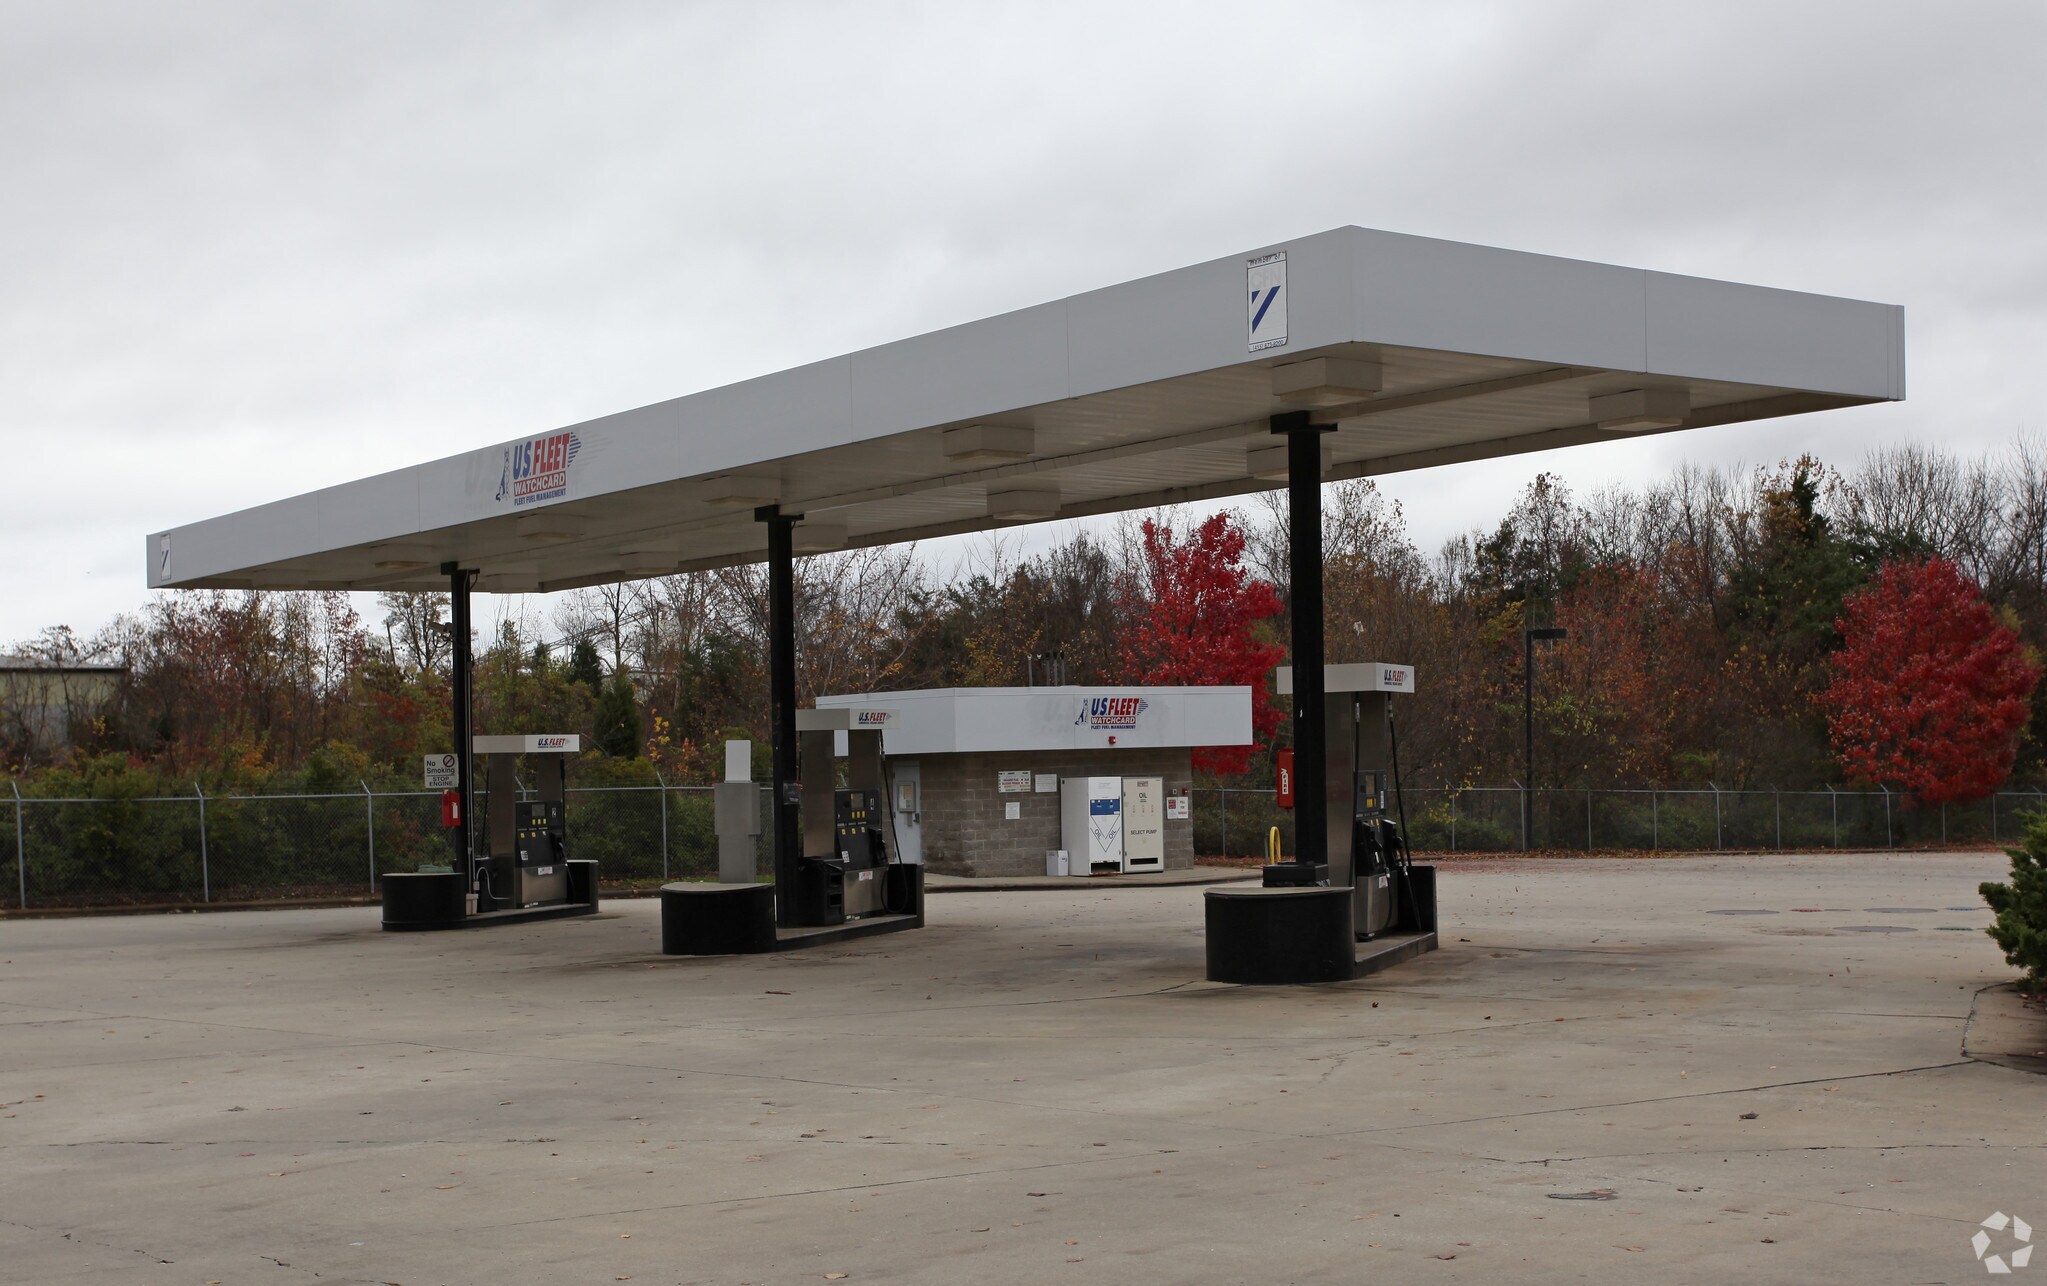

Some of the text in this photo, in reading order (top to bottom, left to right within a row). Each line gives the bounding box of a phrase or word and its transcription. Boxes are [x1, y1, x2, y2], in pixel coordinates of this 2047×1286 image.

[532, 432, 570, 476] FLEET
[514, 472, 565, 496] WATCHCARD
[514, 488, 566, 506] FLEET FUEL MANAGEMENT
[1108, 698, 1139, 716] FLEET
[869, 712, 887, 721] FLEET
[1091, 716, 1136, 724] WATCHCARD
[549, 738, 566, 746] FLEET
[427, 767, 455, 775] Smoking
[1108, 830, 1116, 840] OIL
